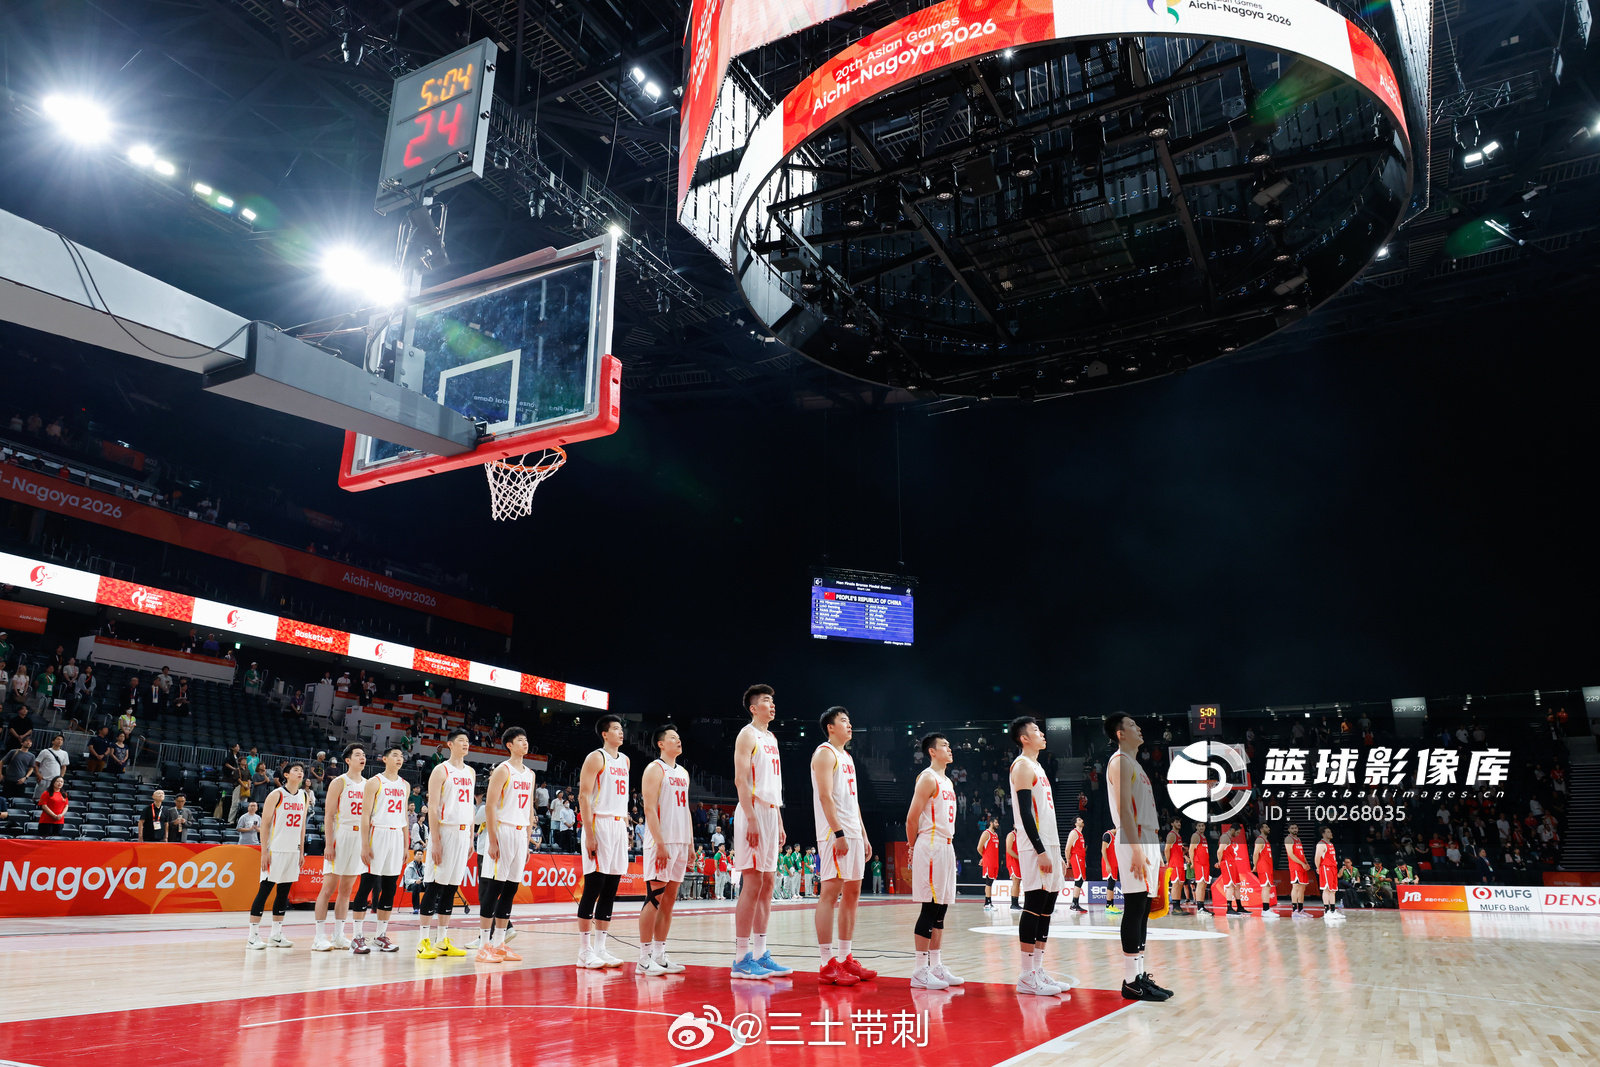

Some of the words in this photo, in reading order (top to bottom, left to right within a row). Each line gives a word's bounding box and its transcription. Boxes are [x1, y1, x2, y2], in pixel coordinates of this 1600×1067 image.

[1188, 0, 1264, 19] Aichi-Nagoya
[1266, 12, 1292, 26] 2026
[835, 58, 863, 82] 20th
[867, 38, 902, 64] Asian
[906, 16, 960, 43] Games
[812, 40, 935, 115] Aichi-Nagoya
[941, 18, 997, 48] 2026
[419, 63, 473, 111] 5:04
[403, 103, 463, 168] 24
[81, 497, 122, 518] 2026
[342, 572, 412, 601] Aichi-Nagoya
[413, 592, 437, 607] 2026
[858, 596, 879, 604] REPUBLIC
[295, 629, 334, 644] Basketball
[1200, 707, 1217, 717] 5:04
[1199, 718, 1216, 730] 24
[610, 766, 628, 776] CHINA
[772, 758, 779, 776] 11
[453, 777, 473, 786] CHINA
[513, 781, 531, 790] CHINA
[615, 780, 626, 795] 16
[669, 777, 687, 787] CHINA
[348, 790, 363, 799] CHIN
[384, 788, 405, 797] CHINA
[458, 789, 469, 803] 21
[675, 790, 686, 807] 14
[283, 802, 303, 811] CHINA
[388, 800, 402, 813] 24
[518, 794, 529, 809] 17
[286, 814, 301, 827] 32
[949, 806, 954, 823] 9
[0, 861, 147, 900] Nagoya
[156, 862, 235, 889] 2026
[537, 867, 577, 887] 2026
[1402, 892, 1422, 903] JTB
[1495, 890, 1532, 898] MUFG
[1544, 894, 1600, 907] DENS
